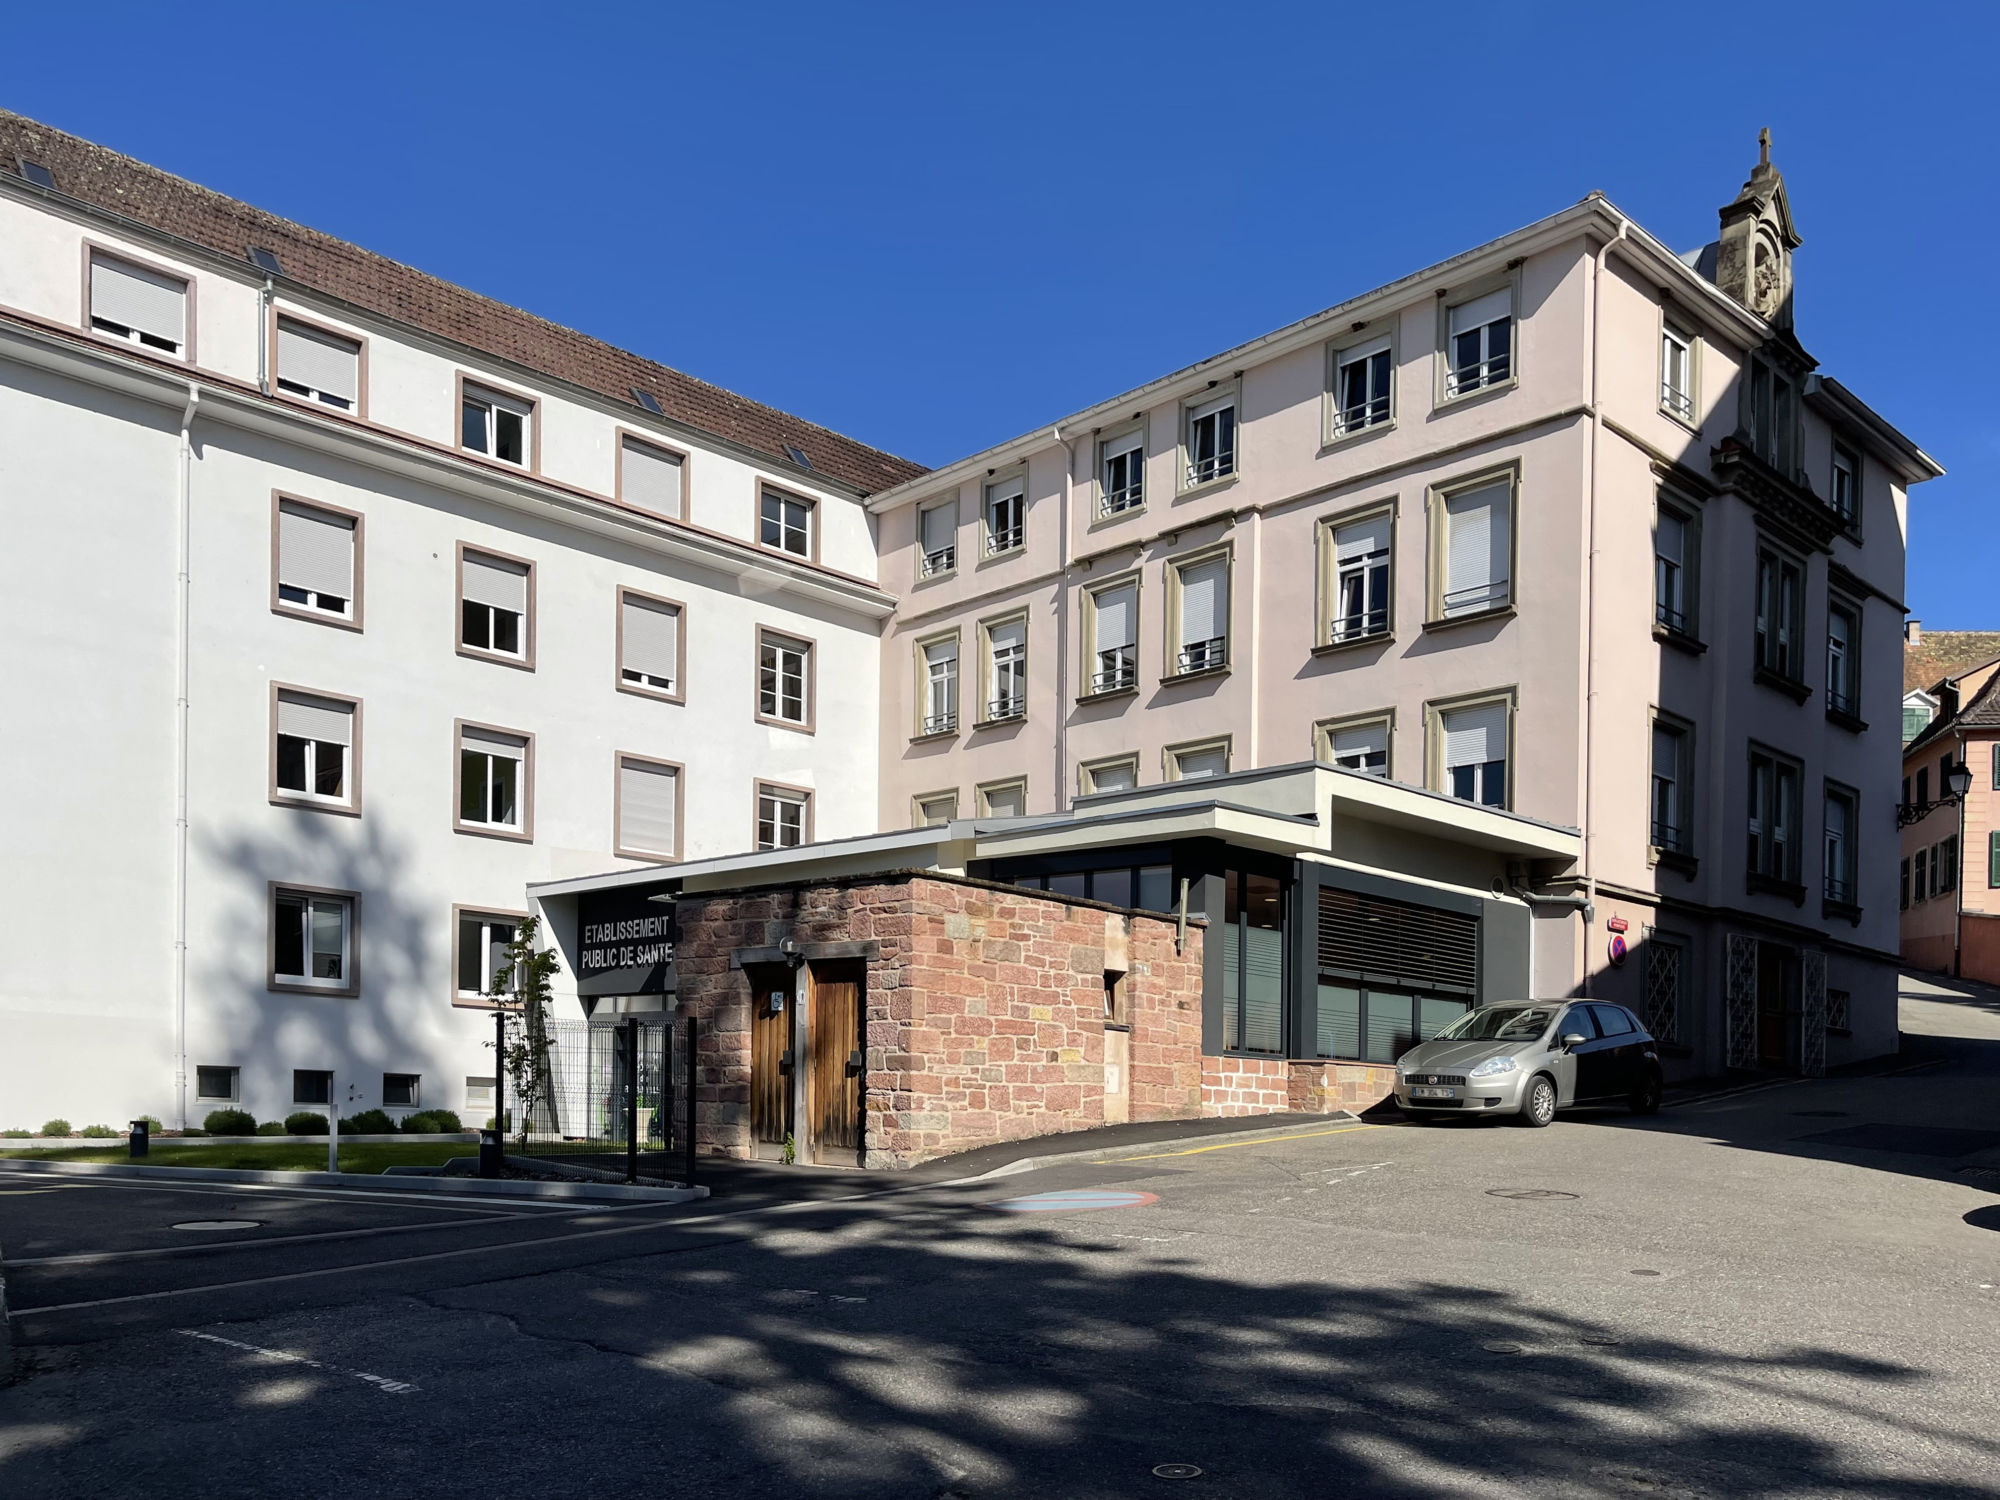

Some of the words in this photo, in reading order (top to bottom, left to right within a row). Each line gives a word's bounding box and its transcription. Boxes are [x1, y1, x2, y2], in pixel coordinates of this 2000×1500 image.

[584, 916, 669, 944] ETABLISSEMENT
[582, 948, 617, 969] PUBLIC
[619, 946, 634, 966] DE
[636, 942, 673, 965] SANTE
